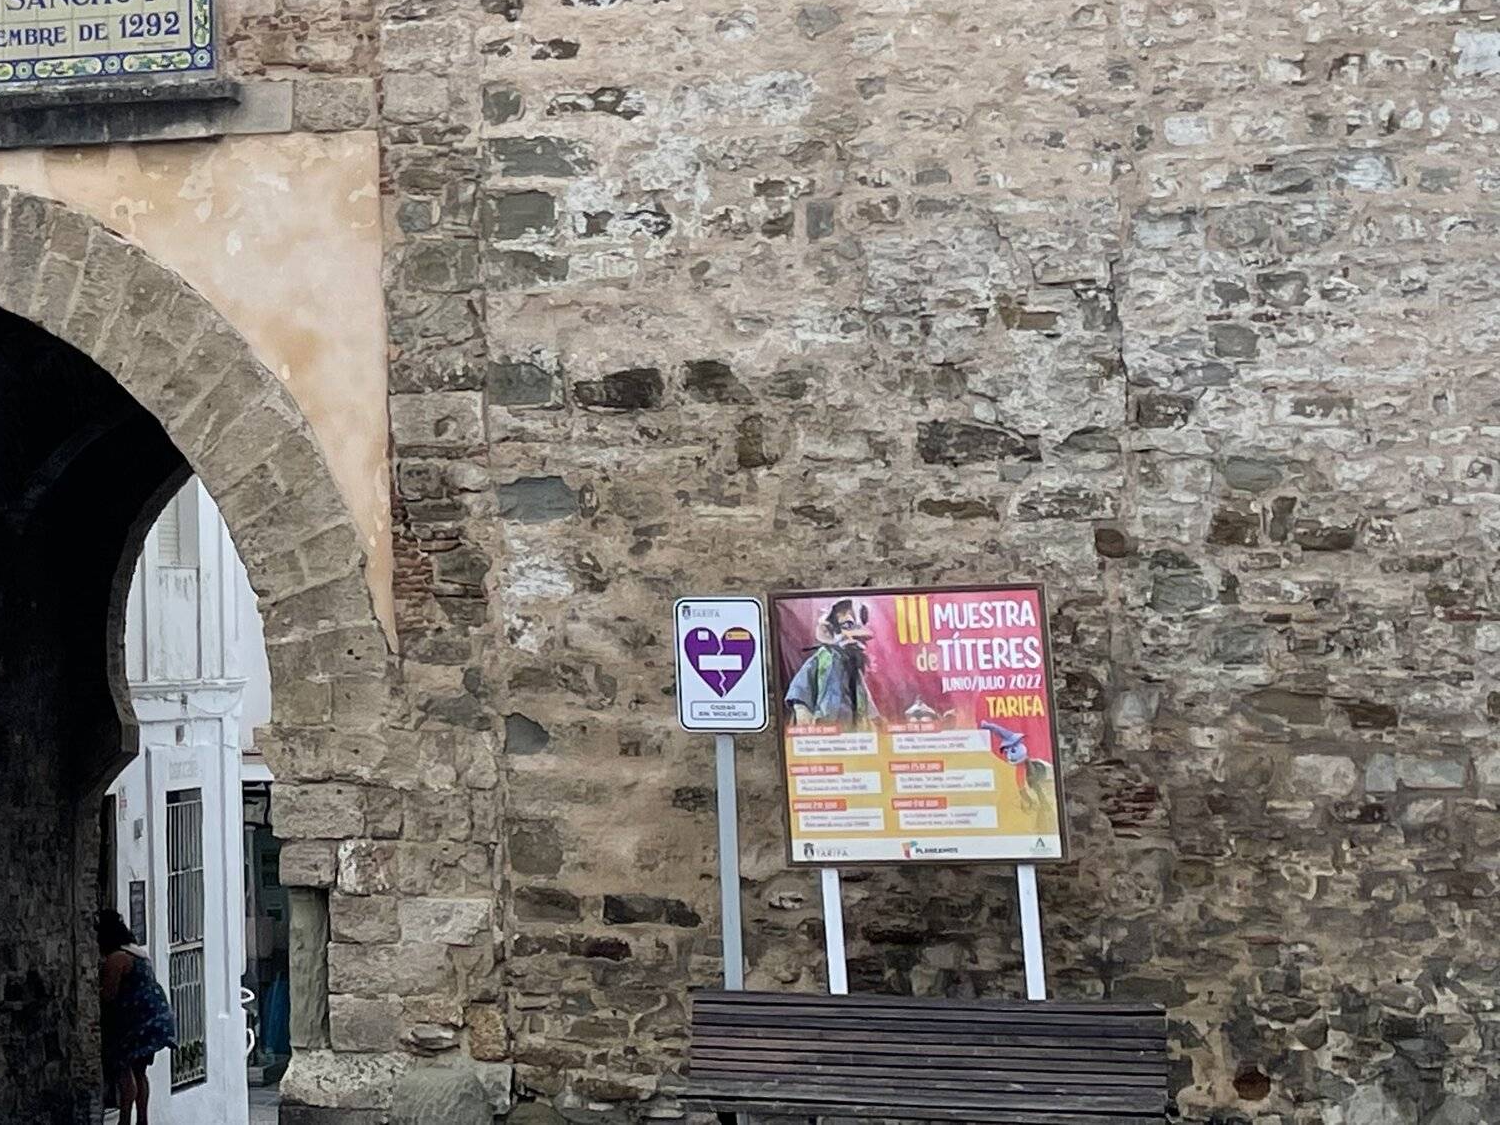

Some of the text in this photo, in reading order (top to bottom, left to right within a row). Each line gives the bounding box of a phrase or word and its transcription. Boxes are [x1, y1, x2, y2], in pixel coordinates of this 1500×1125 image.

[79, 22, 109, 42] DE
[119, 10, 180, 39] 1292
[933, 600, 1037, 631] MUESTRA
[916, 631, 1042, 672] de TÍTERES
[941, 673, 1042, 694] JUNIO/JULIO 2022
[985, 694, 1045, 719] TARIFA
